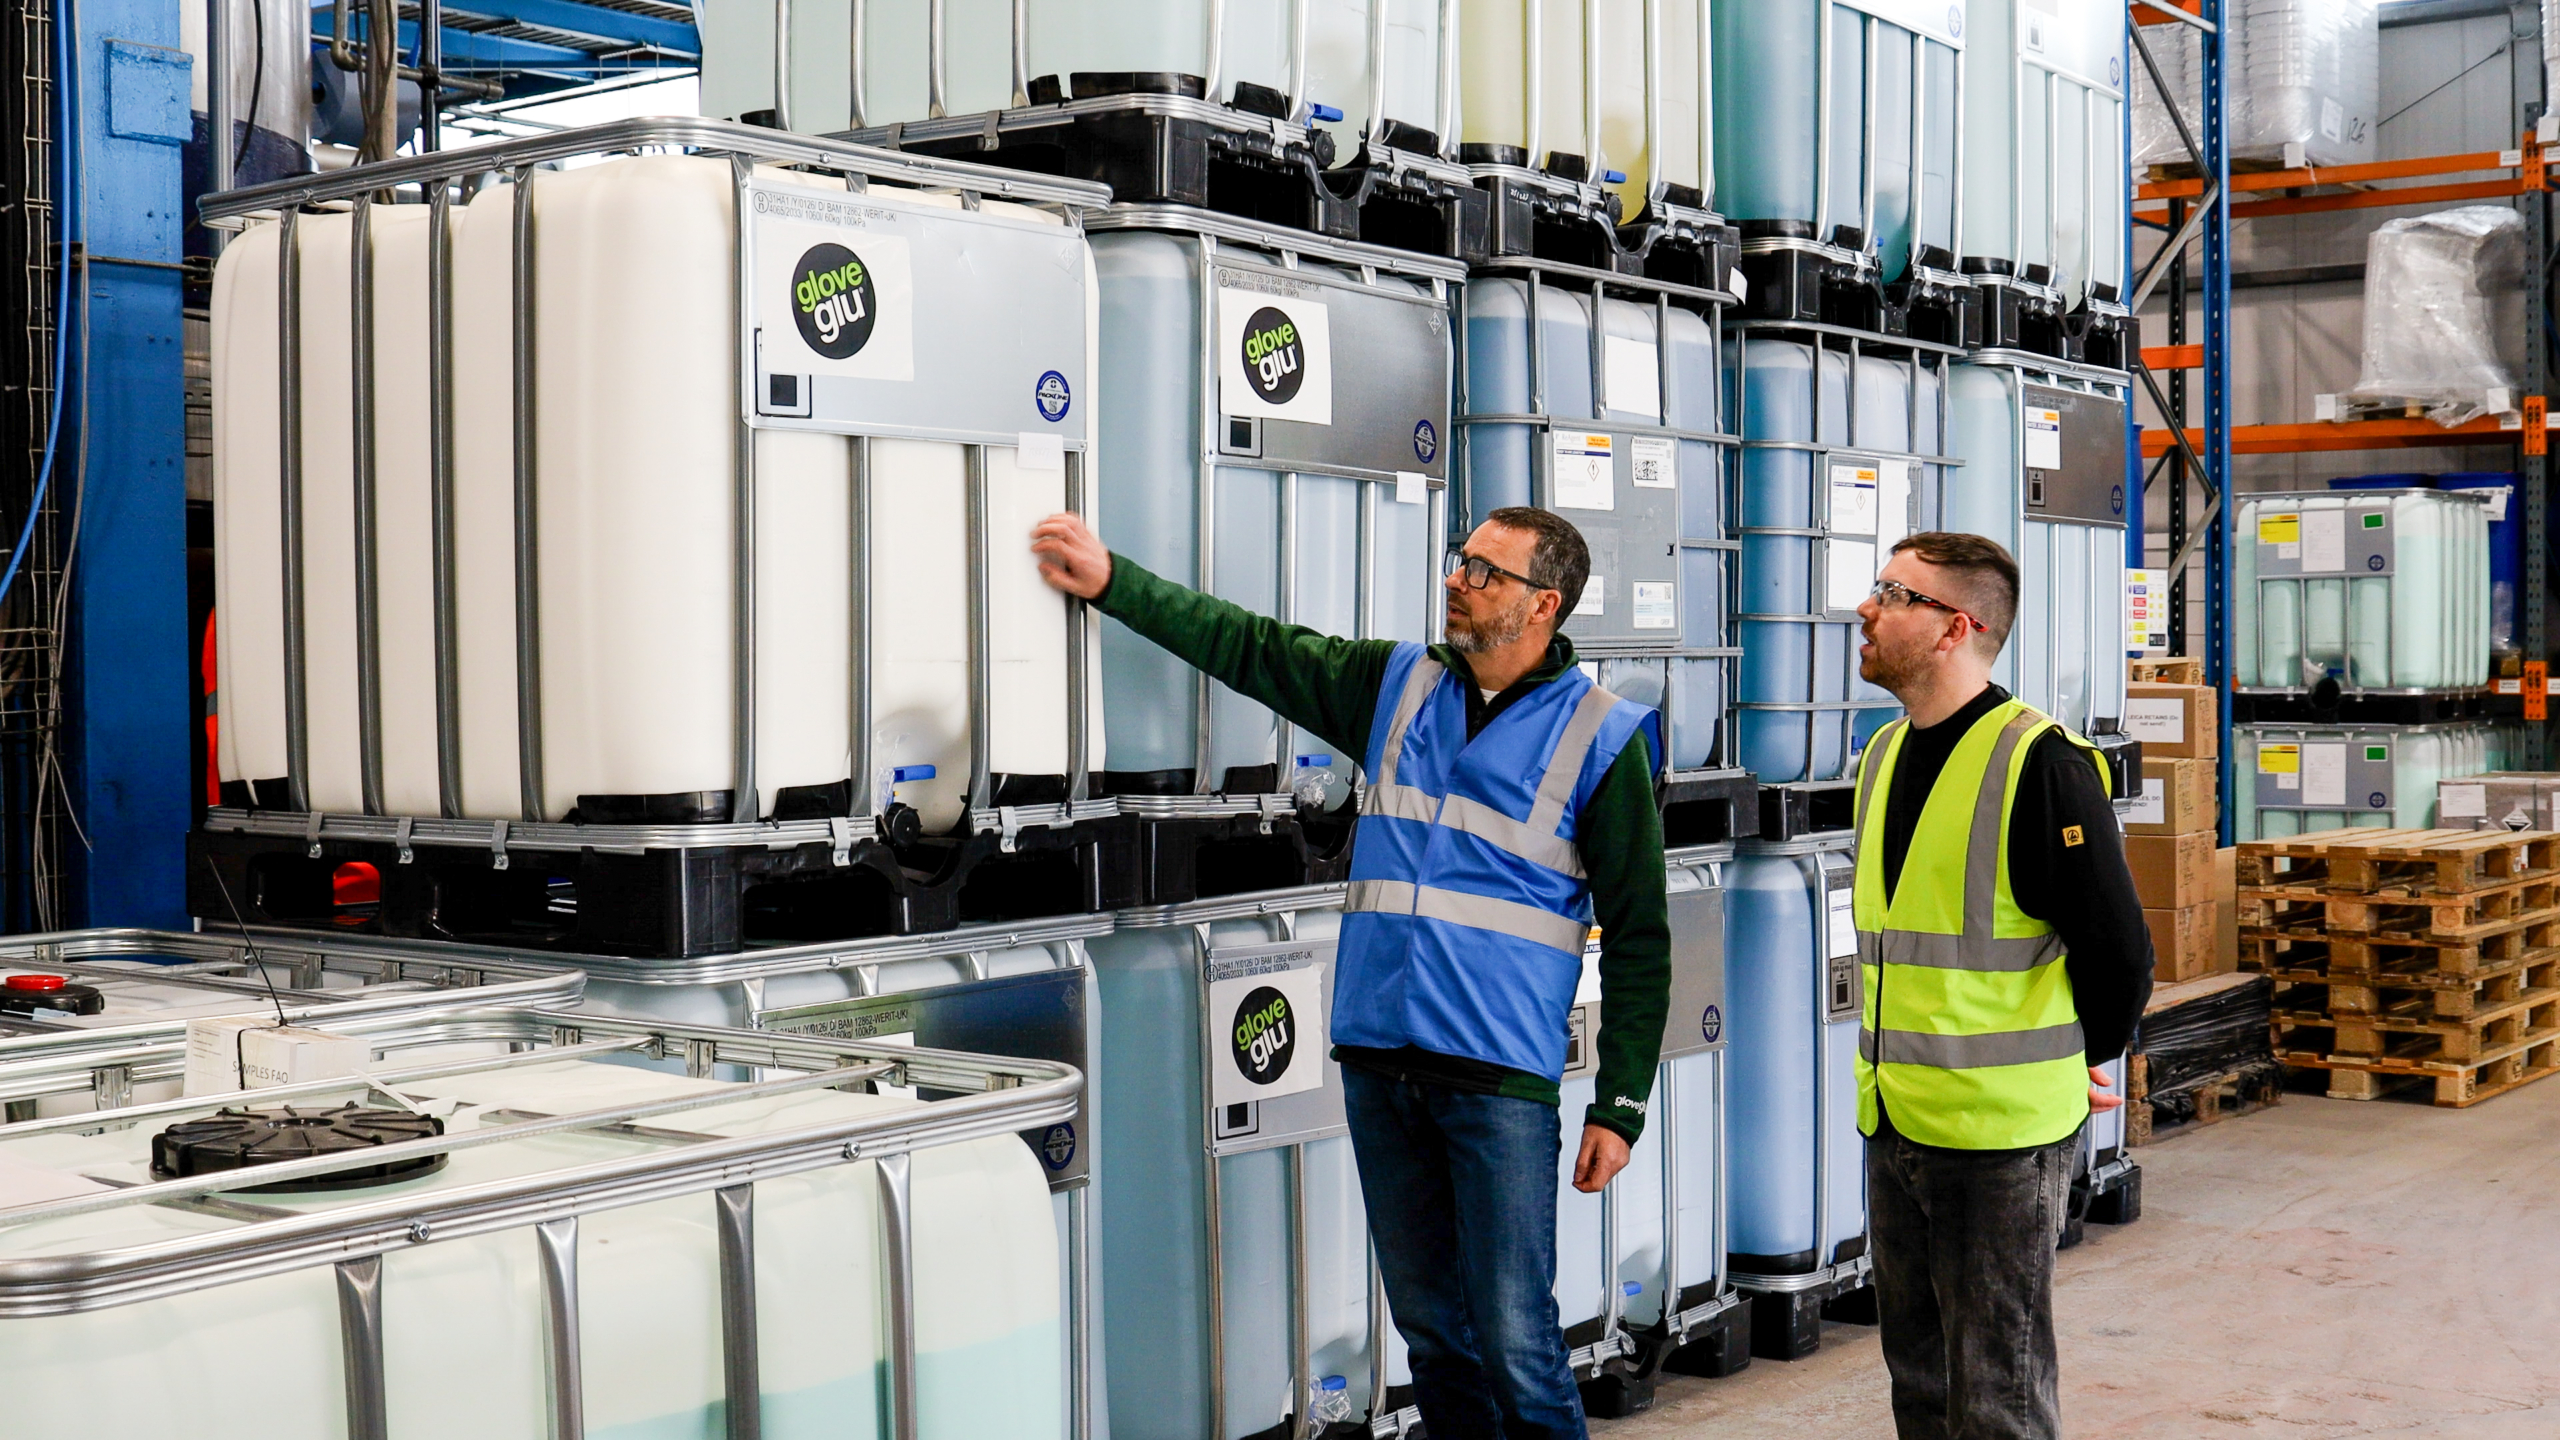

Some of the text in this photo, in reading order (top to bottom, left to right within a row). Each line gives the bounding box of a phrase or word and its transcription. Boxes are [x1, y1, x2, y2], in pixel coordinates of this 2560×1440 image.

[827, 203, 841, 214] BAM
[796, 262, 863, 313] glove
[814, 288, 866, 344] glu
[1245, 323, 1295, 365] glove
[1259, 345, 1297, 391] glu
[838, 1017, 853, 1030] BAM
[855, 1025, 878, 1037] 100kPa
[1236, 998, 1286, 1051] glove
[1250, 1019, 1288, 1073] glu
[271, 1069, 289, 1084] FAO
